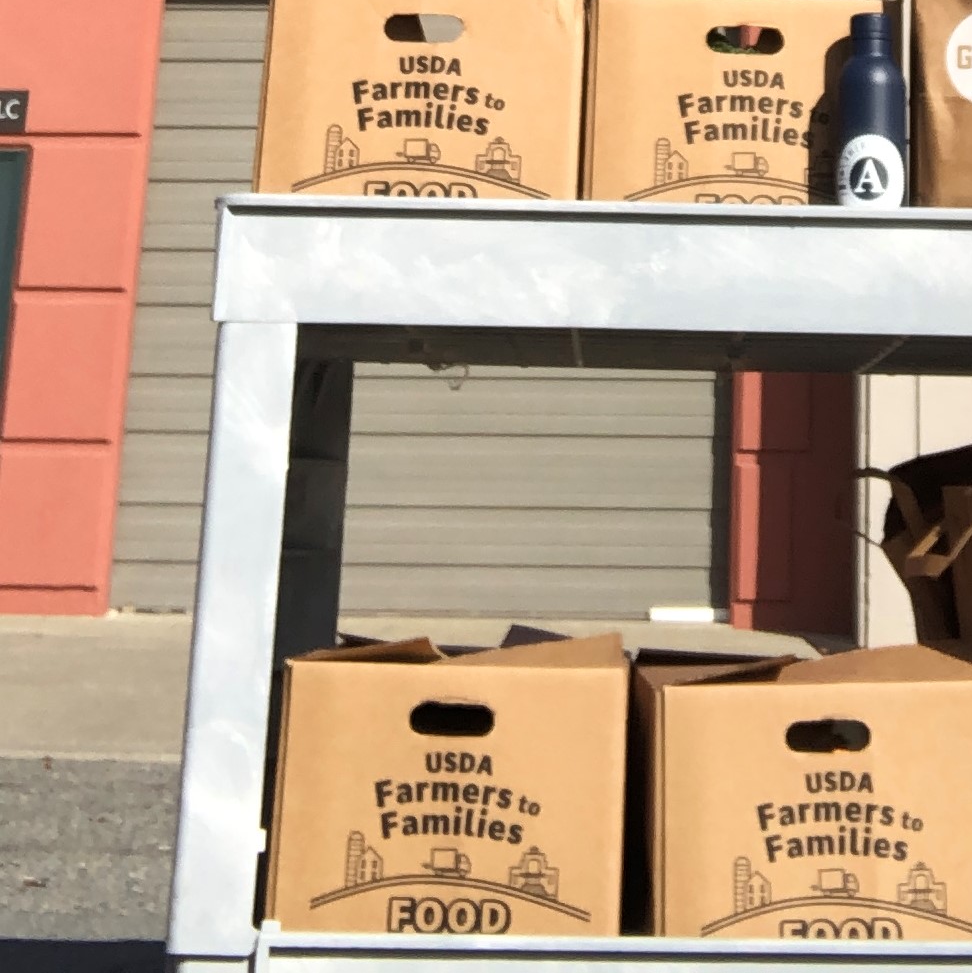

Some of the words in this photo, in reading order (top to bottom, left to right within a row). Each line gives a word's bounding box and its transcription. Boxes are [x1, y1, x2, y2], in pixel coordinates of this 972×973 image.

[400, 56, 462, 76] USDA
[723, 69, 785, 89] USDA
[352, 79, 480, 105] Farmers
[485, 93, 505, 111] to
[678, 92, 804, 119] Farmers
[357, 102, 490, 136] Families
[683, 116, 815, 150] Families
[425, 752, 493, 776] USDA
[374, 779, 513, 809] Farmers
[518, 795, 541, 816] to
[805, 771, 874, 793] USDA
[380, 806, 524, 844] Families
[757, 801, 894, 831] Farmers
[902, 811, 924, 832] to
[765, 825, 908, 863] Families
[387, 896, 511, 934] FOOD
